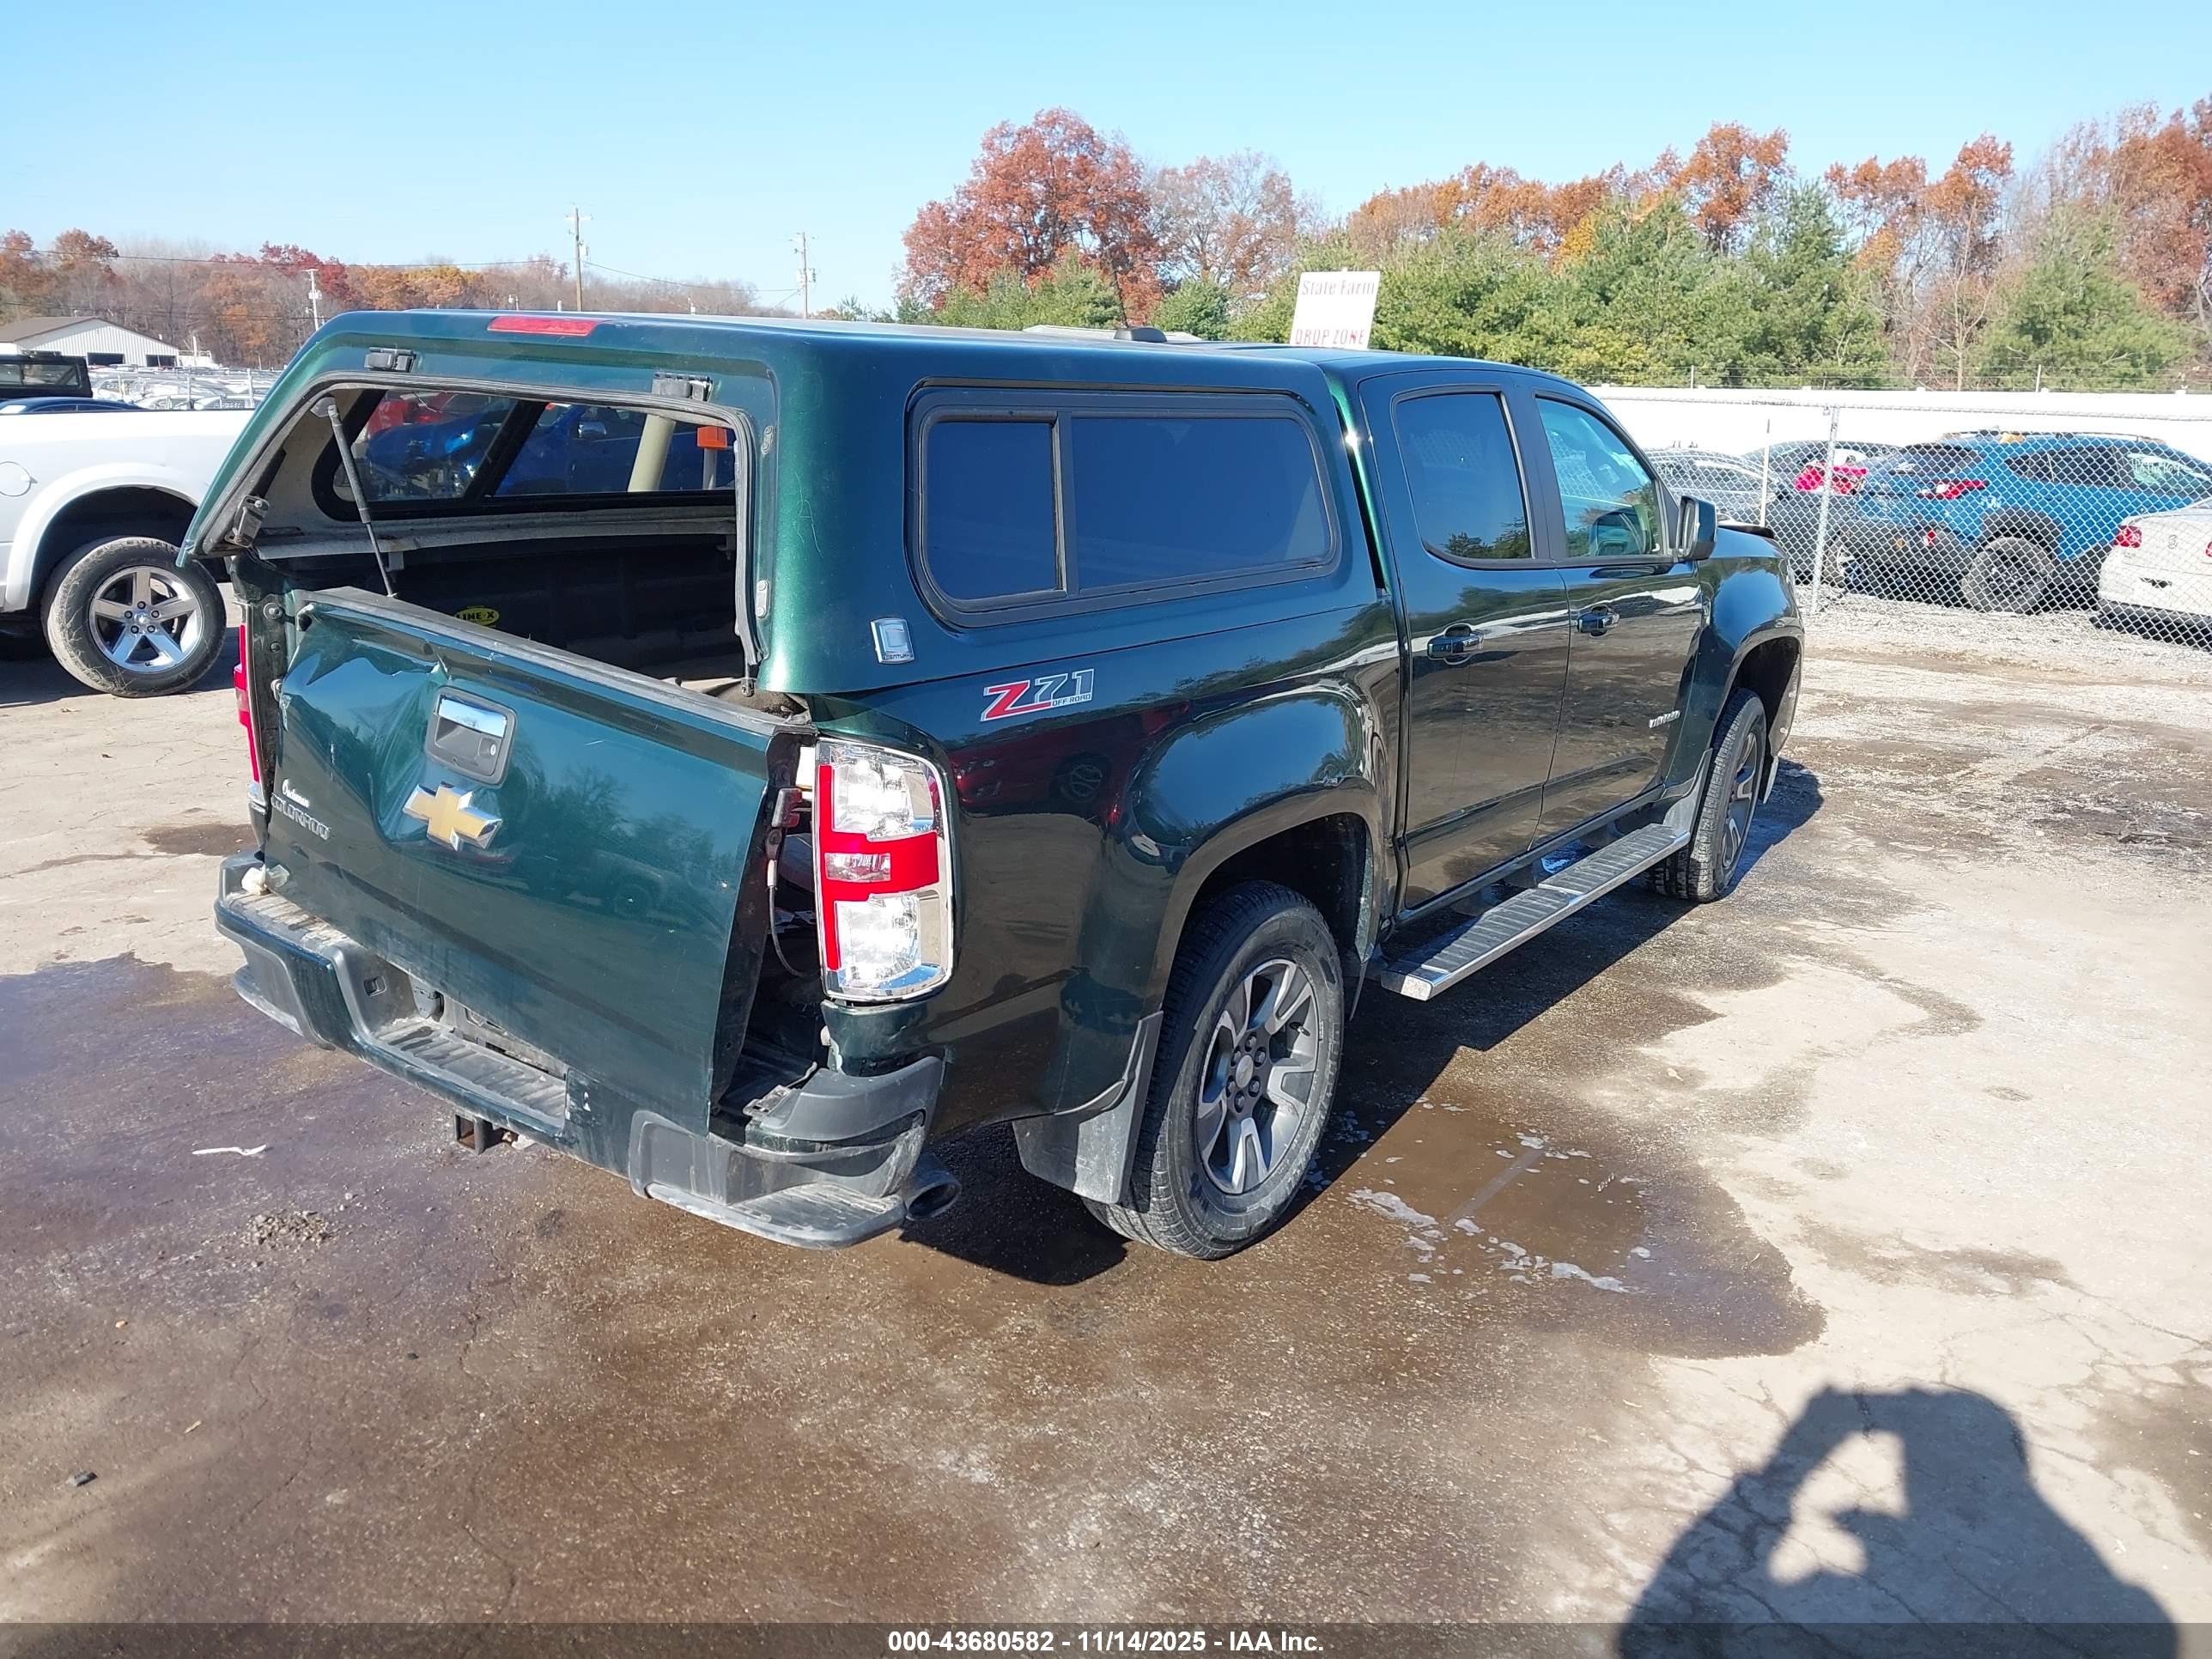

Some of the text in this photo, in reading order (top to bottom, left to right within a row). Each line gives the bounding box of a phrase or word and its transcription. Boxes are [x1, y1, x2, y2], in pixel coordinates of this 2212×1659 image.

[1302, 279, 1375, 295] State Farm
[1295, 329, 1365, 345] DROP ZONE
[980, 668, 1095, 722] Z71
[1052, 692, 1091, 707] OFF ROAD
